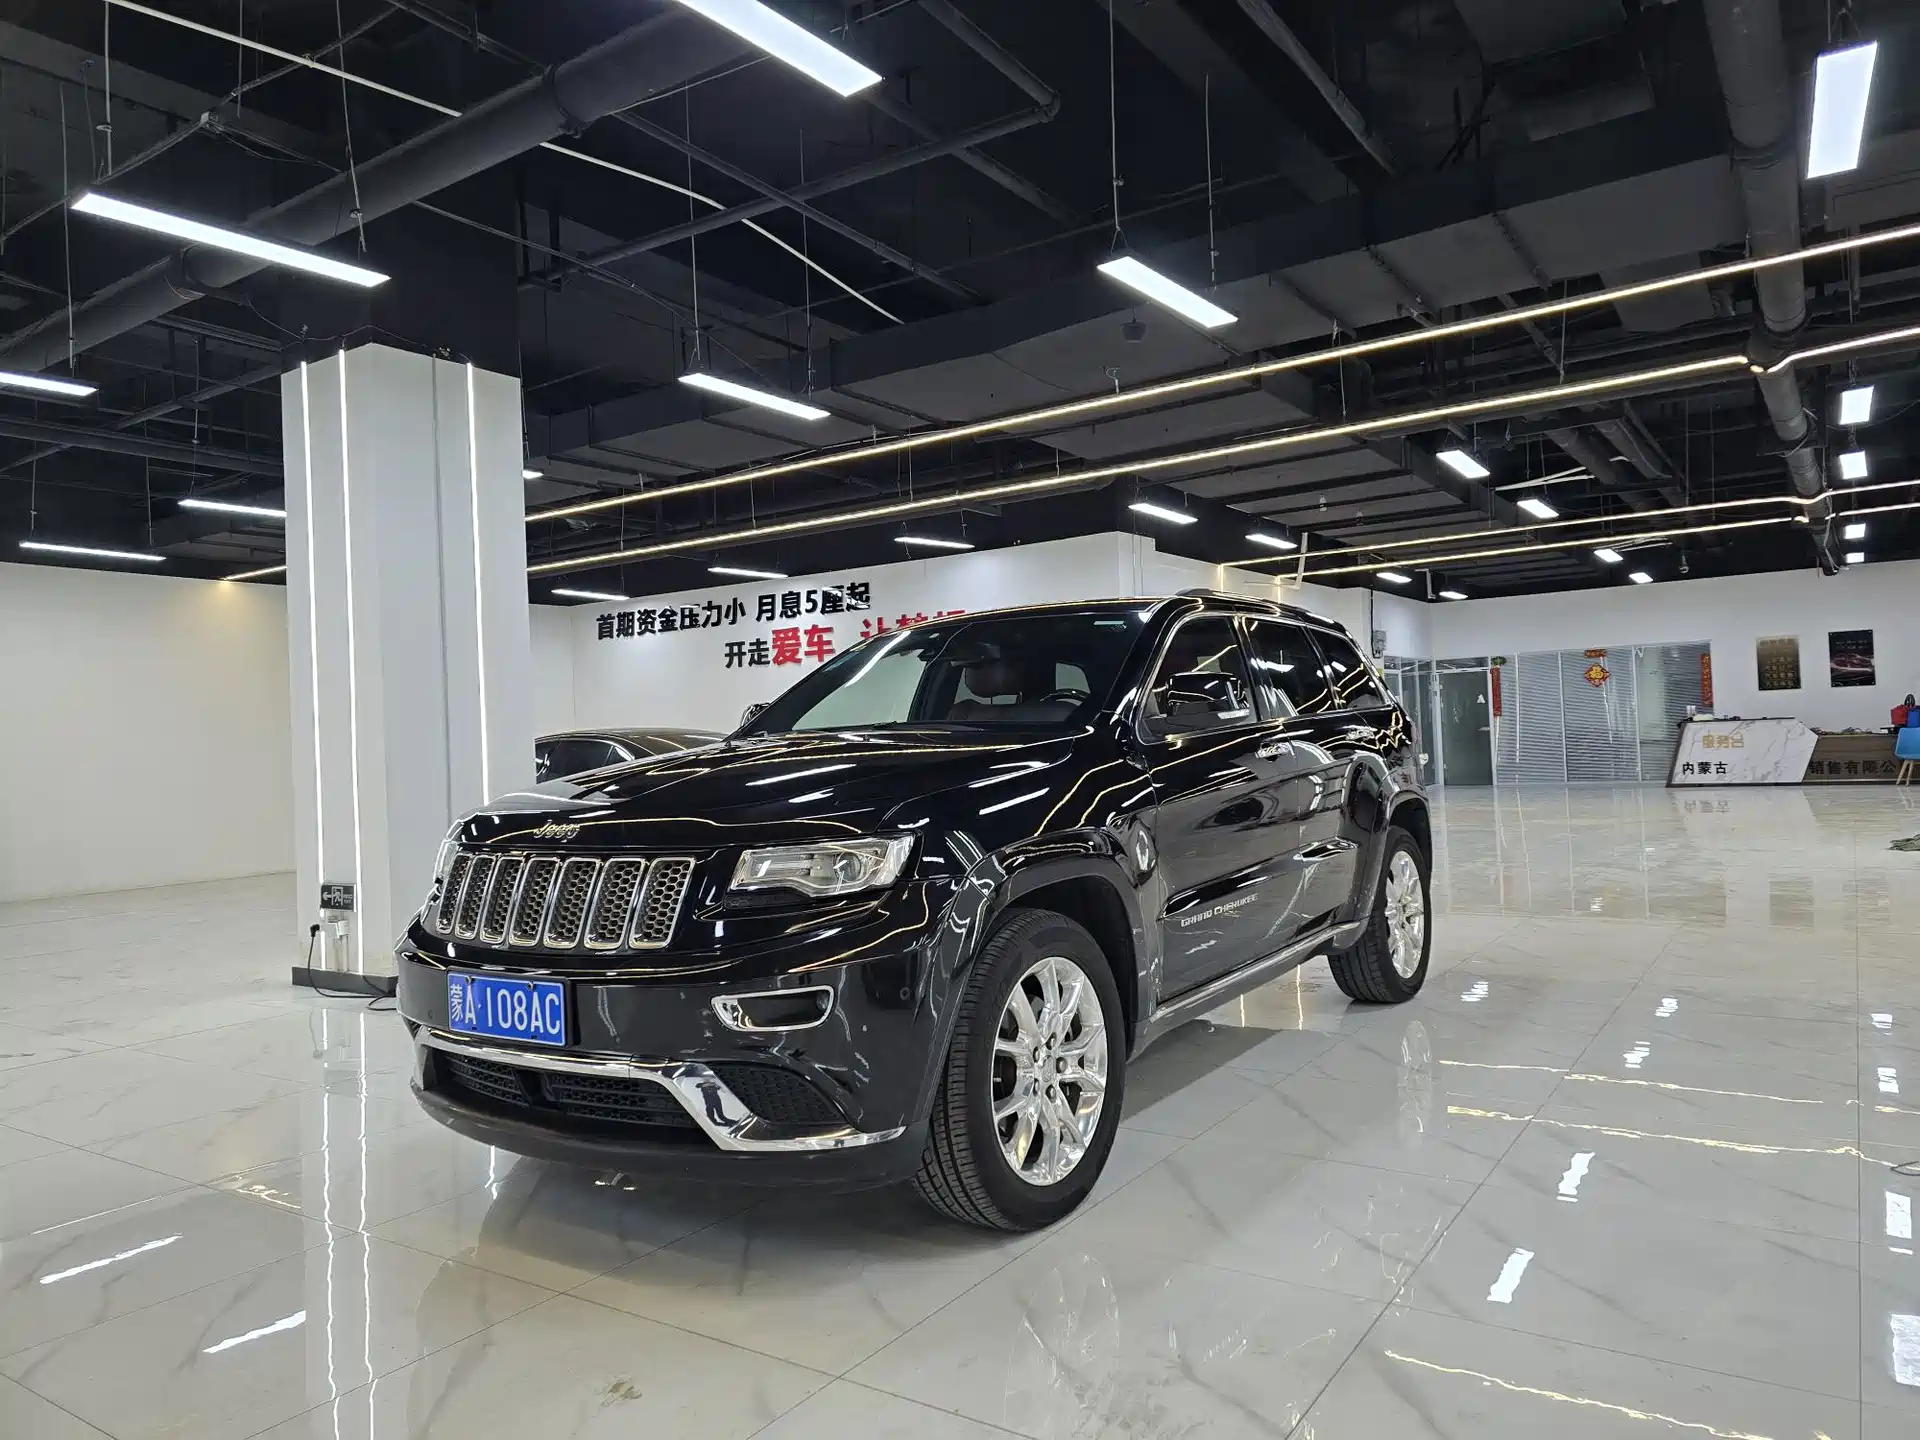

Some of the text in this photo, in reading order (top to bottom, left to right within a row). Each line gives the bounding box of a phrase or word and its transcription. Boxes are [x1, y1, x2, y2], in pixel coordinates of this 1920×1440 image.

[596, 582, 871, 640] 首期资金压力小 月息5厘起
[724, 624, 836, 668] 开走爱车
[1682, 761, 1728, 775] 内蒙古
[1180, 909, 1212, 928] GRAND
